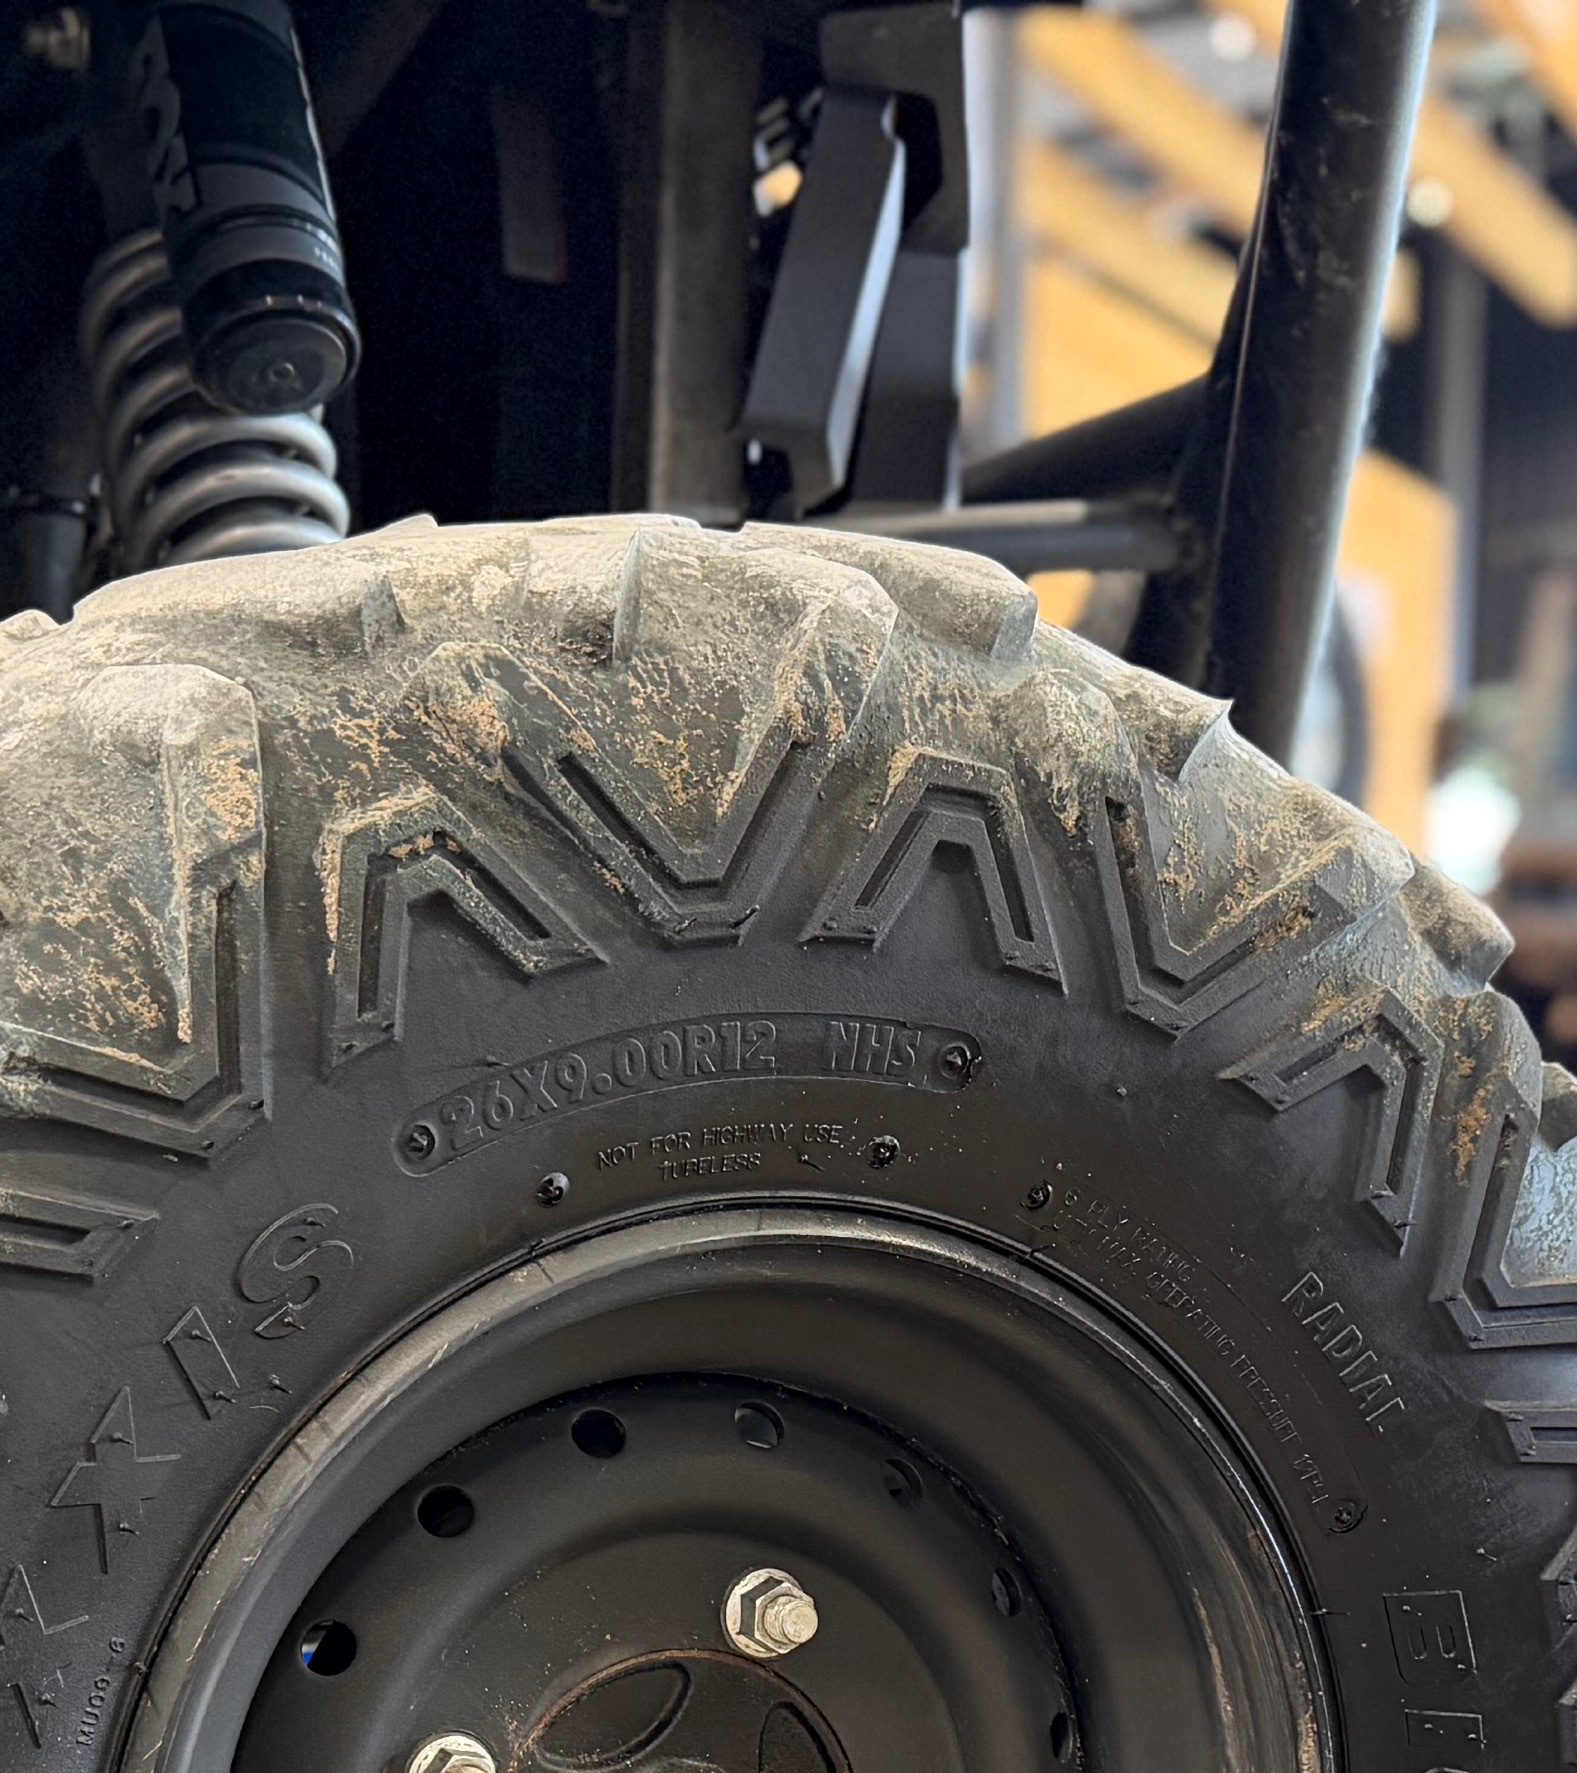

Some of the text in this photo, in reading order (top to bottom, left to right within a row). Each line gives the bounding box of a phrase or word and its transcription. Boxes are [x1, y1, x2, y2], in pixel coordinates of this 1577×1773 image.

[438, 1020, 922, 1152] 26X9.00R12 NHS
[598, 1123, 844, 1171] NOT FOR HIGHWAY USE
[657, 1152, 762, 1181] TUBELESS
[1088, 1200, 1129, 1231] PLY
[1132, 1227, 1195, 1282] RATING
[1145, 1271, 1236, 1356] OPERATING
[1230, 1354, 1304, 1444] PRESSURE
[1281, 1271, 1406, 1434] RADIAL
